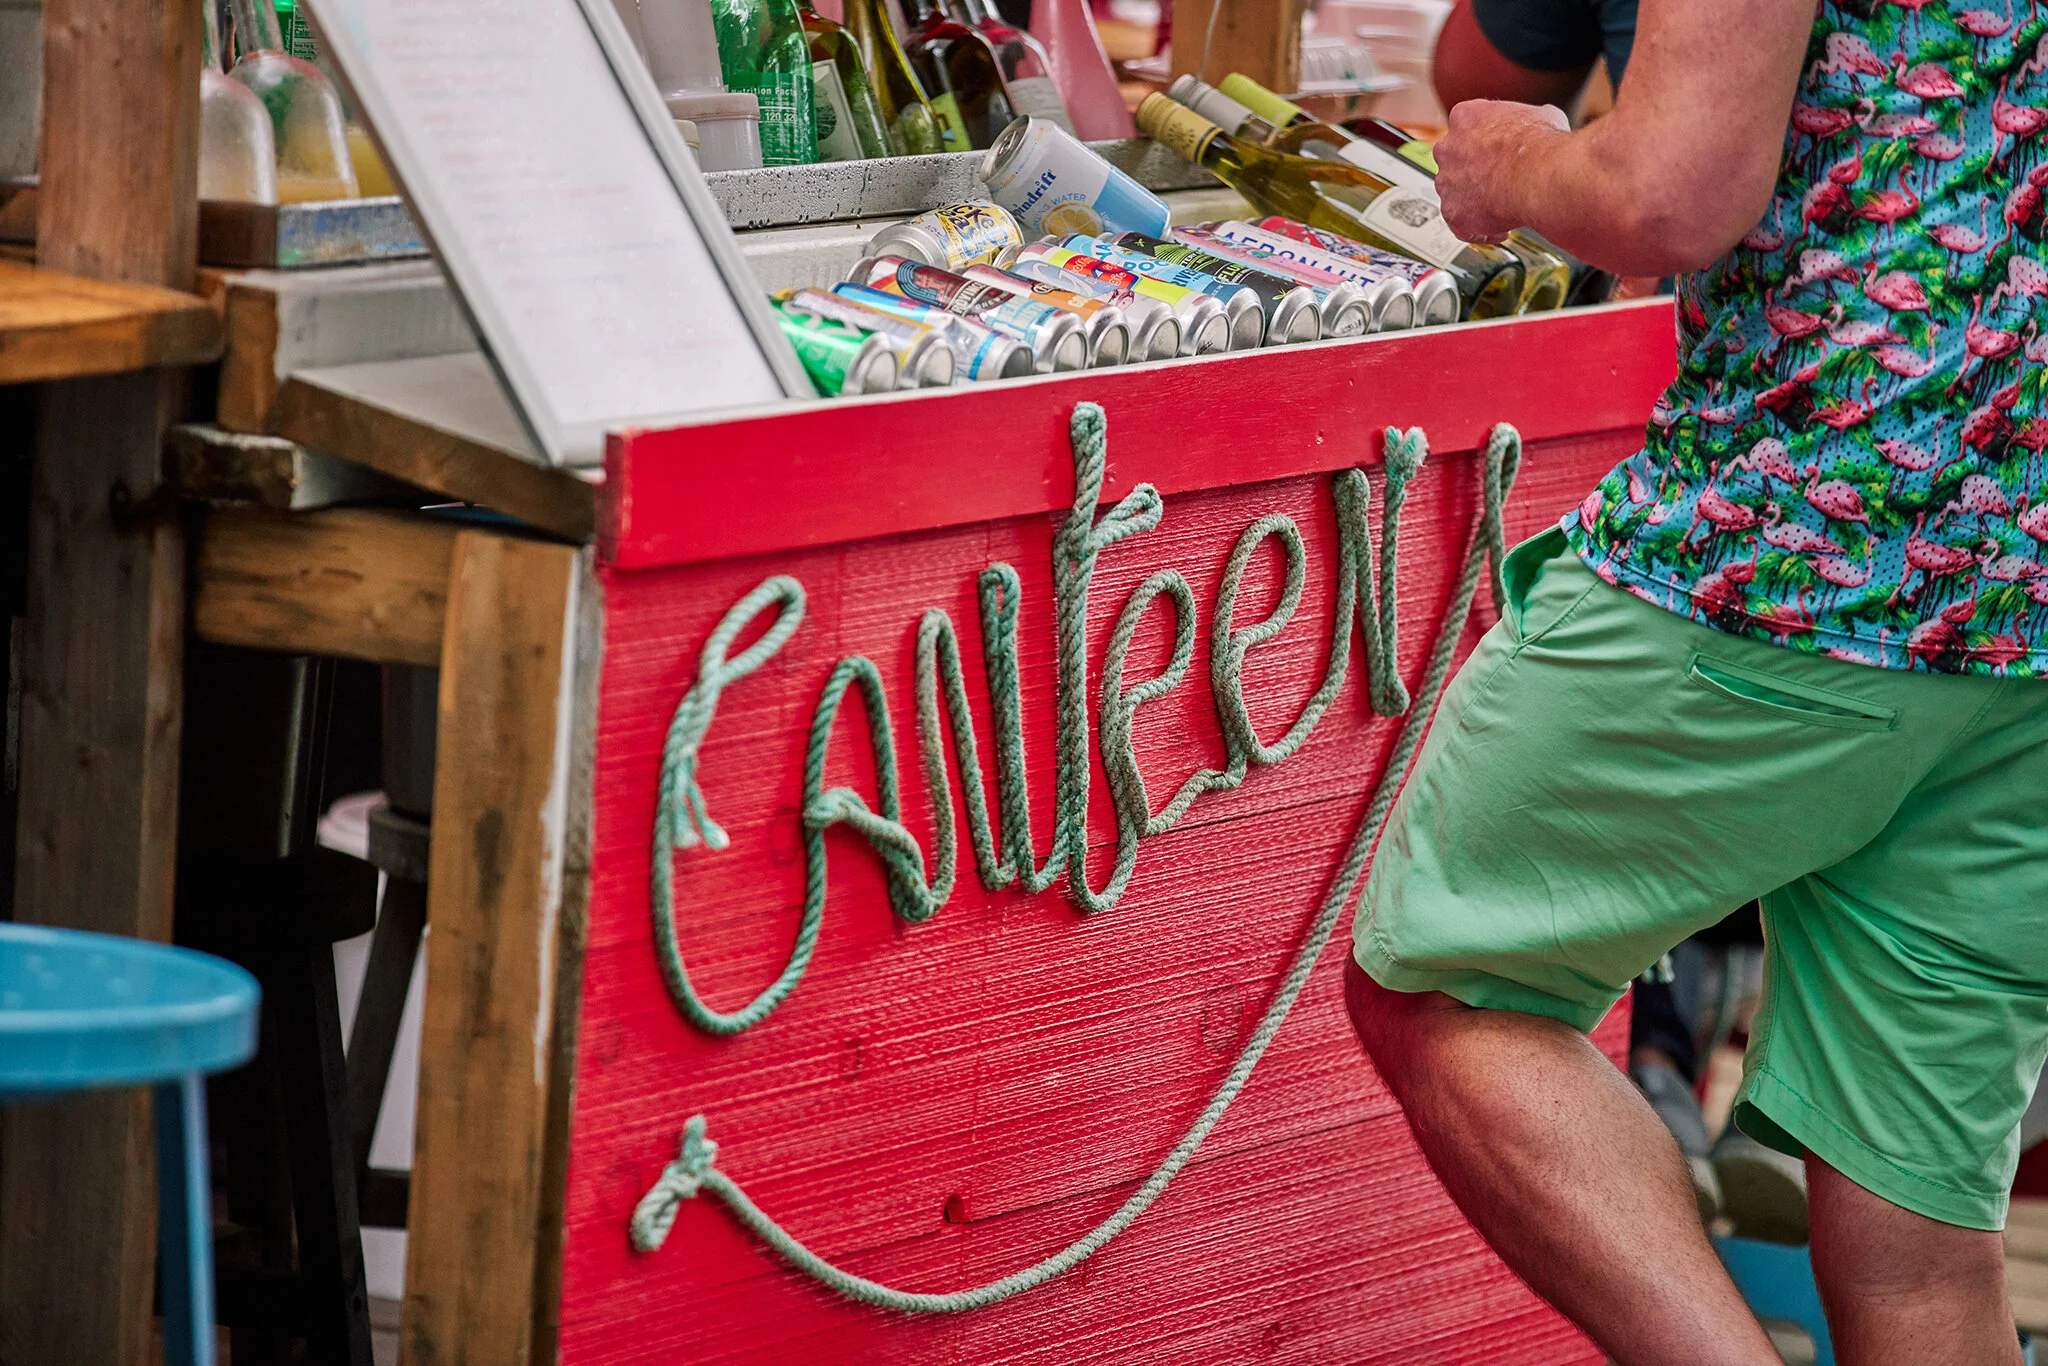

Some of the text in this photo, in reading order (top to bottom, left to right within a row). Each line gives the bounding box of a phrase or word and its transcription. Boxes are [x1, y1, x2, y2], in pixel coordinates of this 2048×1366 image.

[765, 112, 781, 121] 120
[1010, 168, 1057, 220] pindrift
[1052, 192, 1087, 206] WATER
